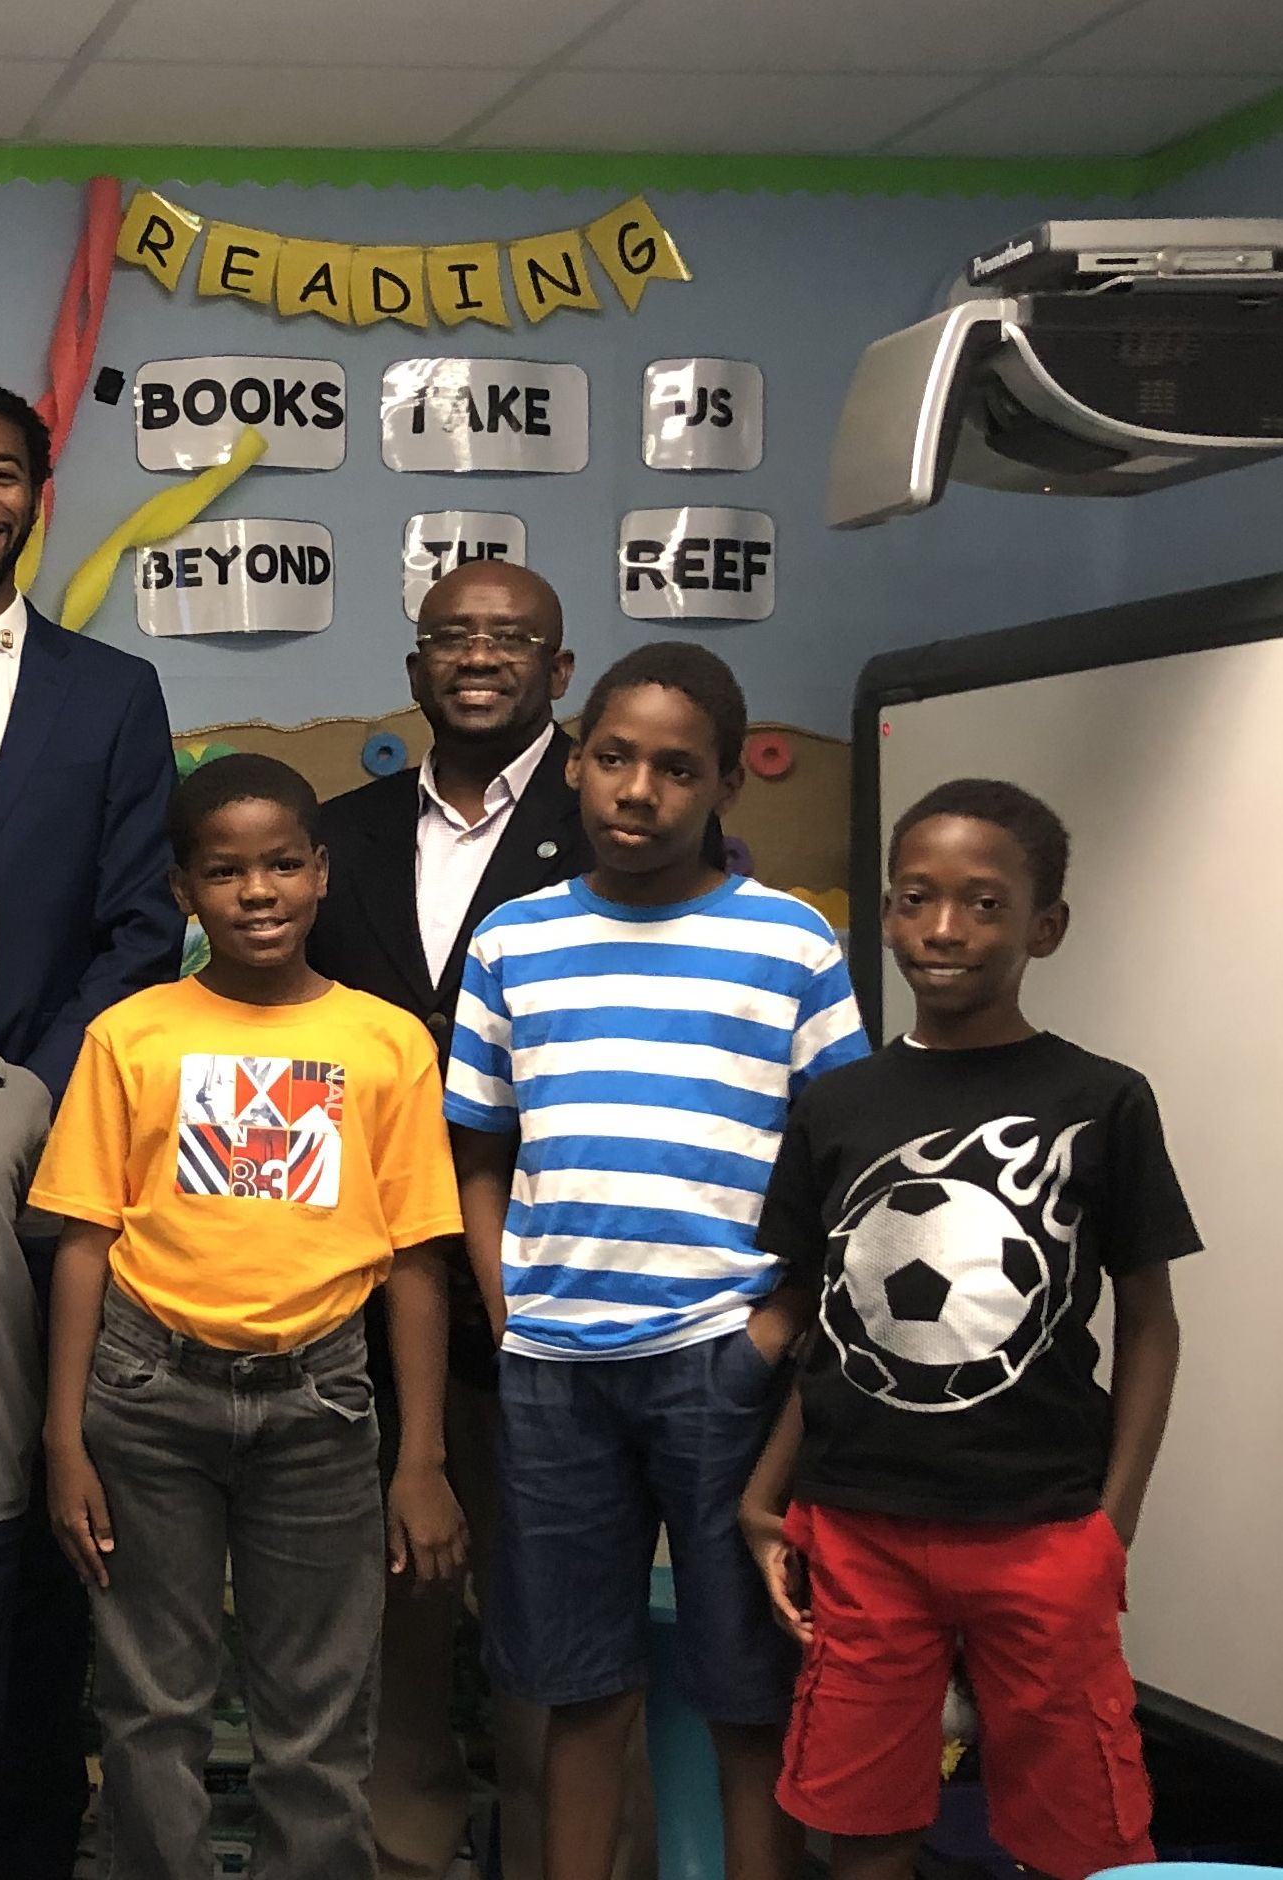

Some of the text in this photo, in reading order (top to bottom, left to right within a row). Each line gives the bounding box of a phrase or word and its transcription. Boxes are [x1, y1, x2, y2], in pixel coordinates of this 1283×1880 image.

[135, 214, 658, 314] READING
[141, 377, 344, 431] BOOKS
[142, 543, 331, 590] BEYOND
[625, 538, 772, 593] REEF
[230, 1156, 289, 1201] 83
